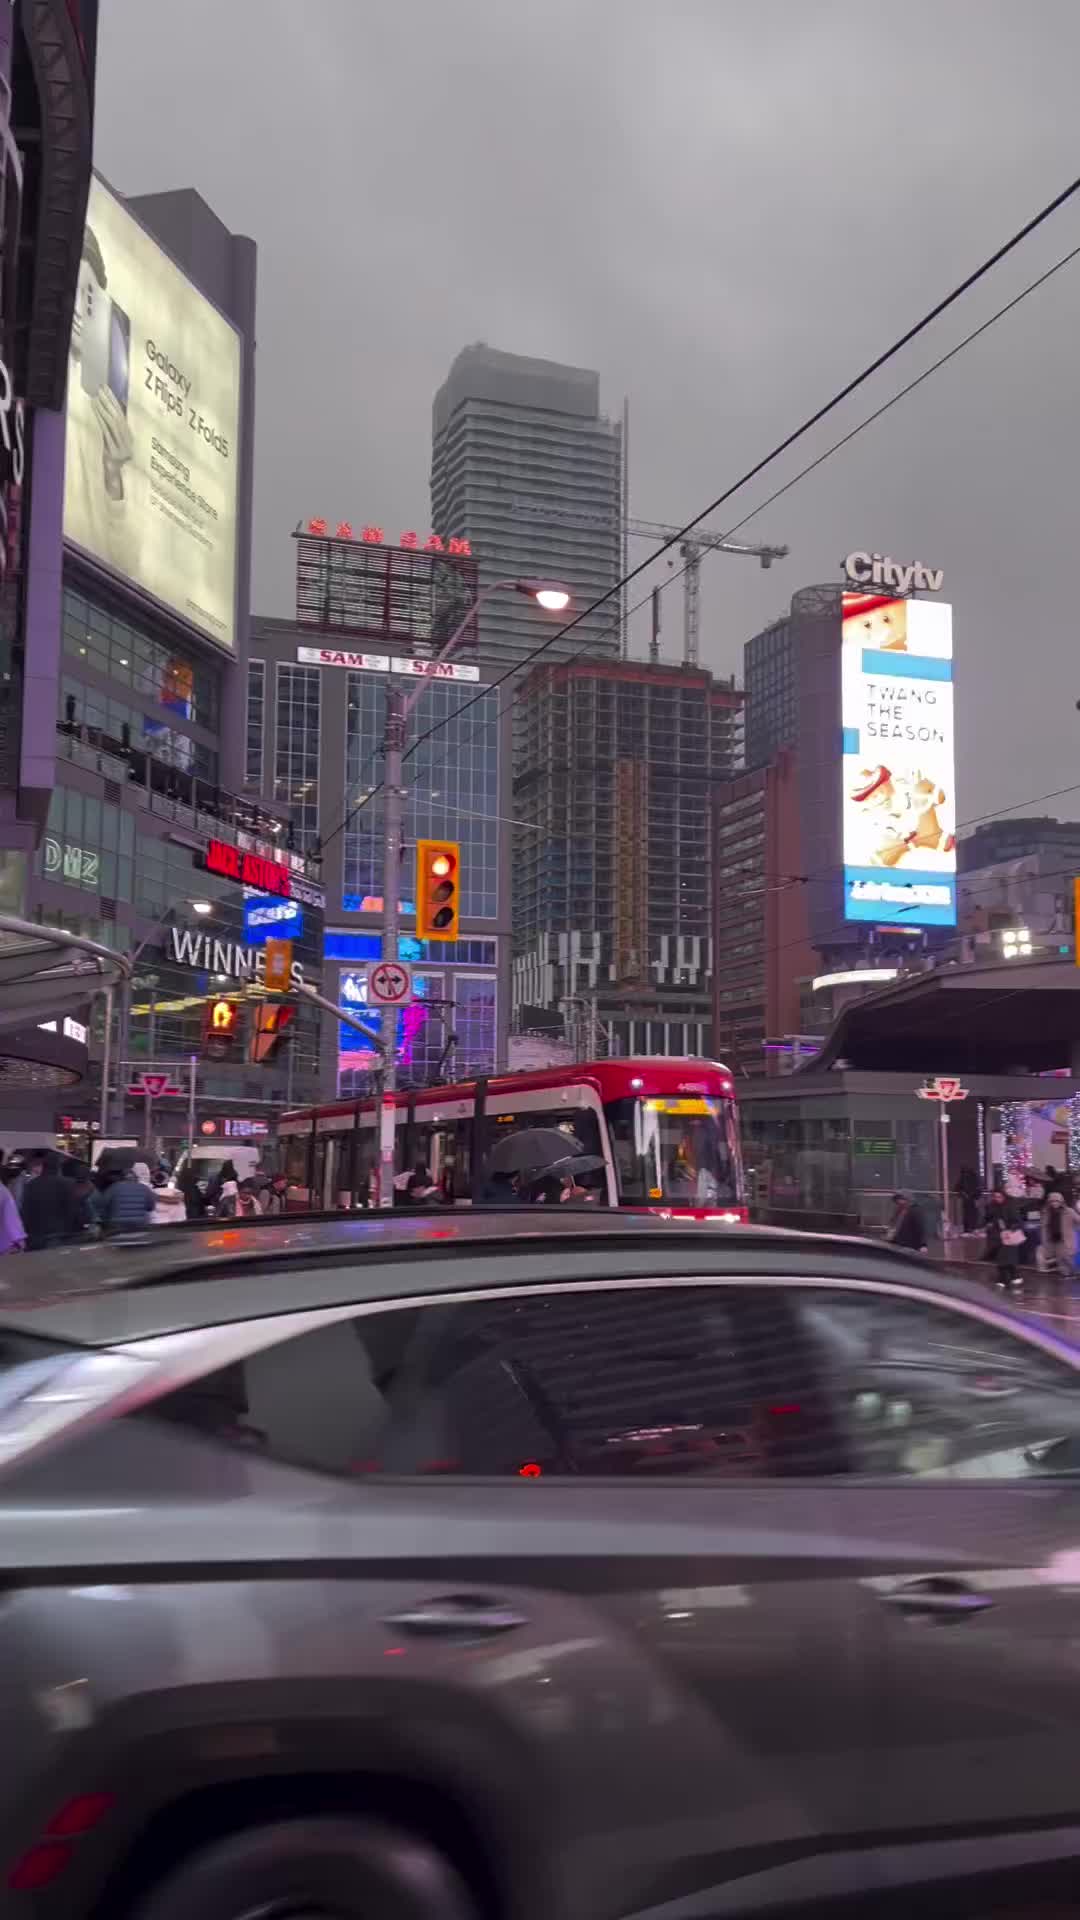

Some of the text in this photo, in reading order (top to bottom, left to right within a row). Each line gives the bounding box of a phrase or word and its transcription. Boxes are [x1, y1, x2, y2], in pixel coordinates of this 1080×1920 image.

[145, 339, 192, 398] Galaxy
[144, 367, 229, 458] Z Flip5 Z Fold5
[399, 531, 473, 557] SAM
[846, 551, 944, 593] Citytv
[319, 650, 364, 667] SAM
[866, 683, 937, 705] TWANG
[866, 703, 903, 721] THE
[866, 721, 944, 743] SEASON
